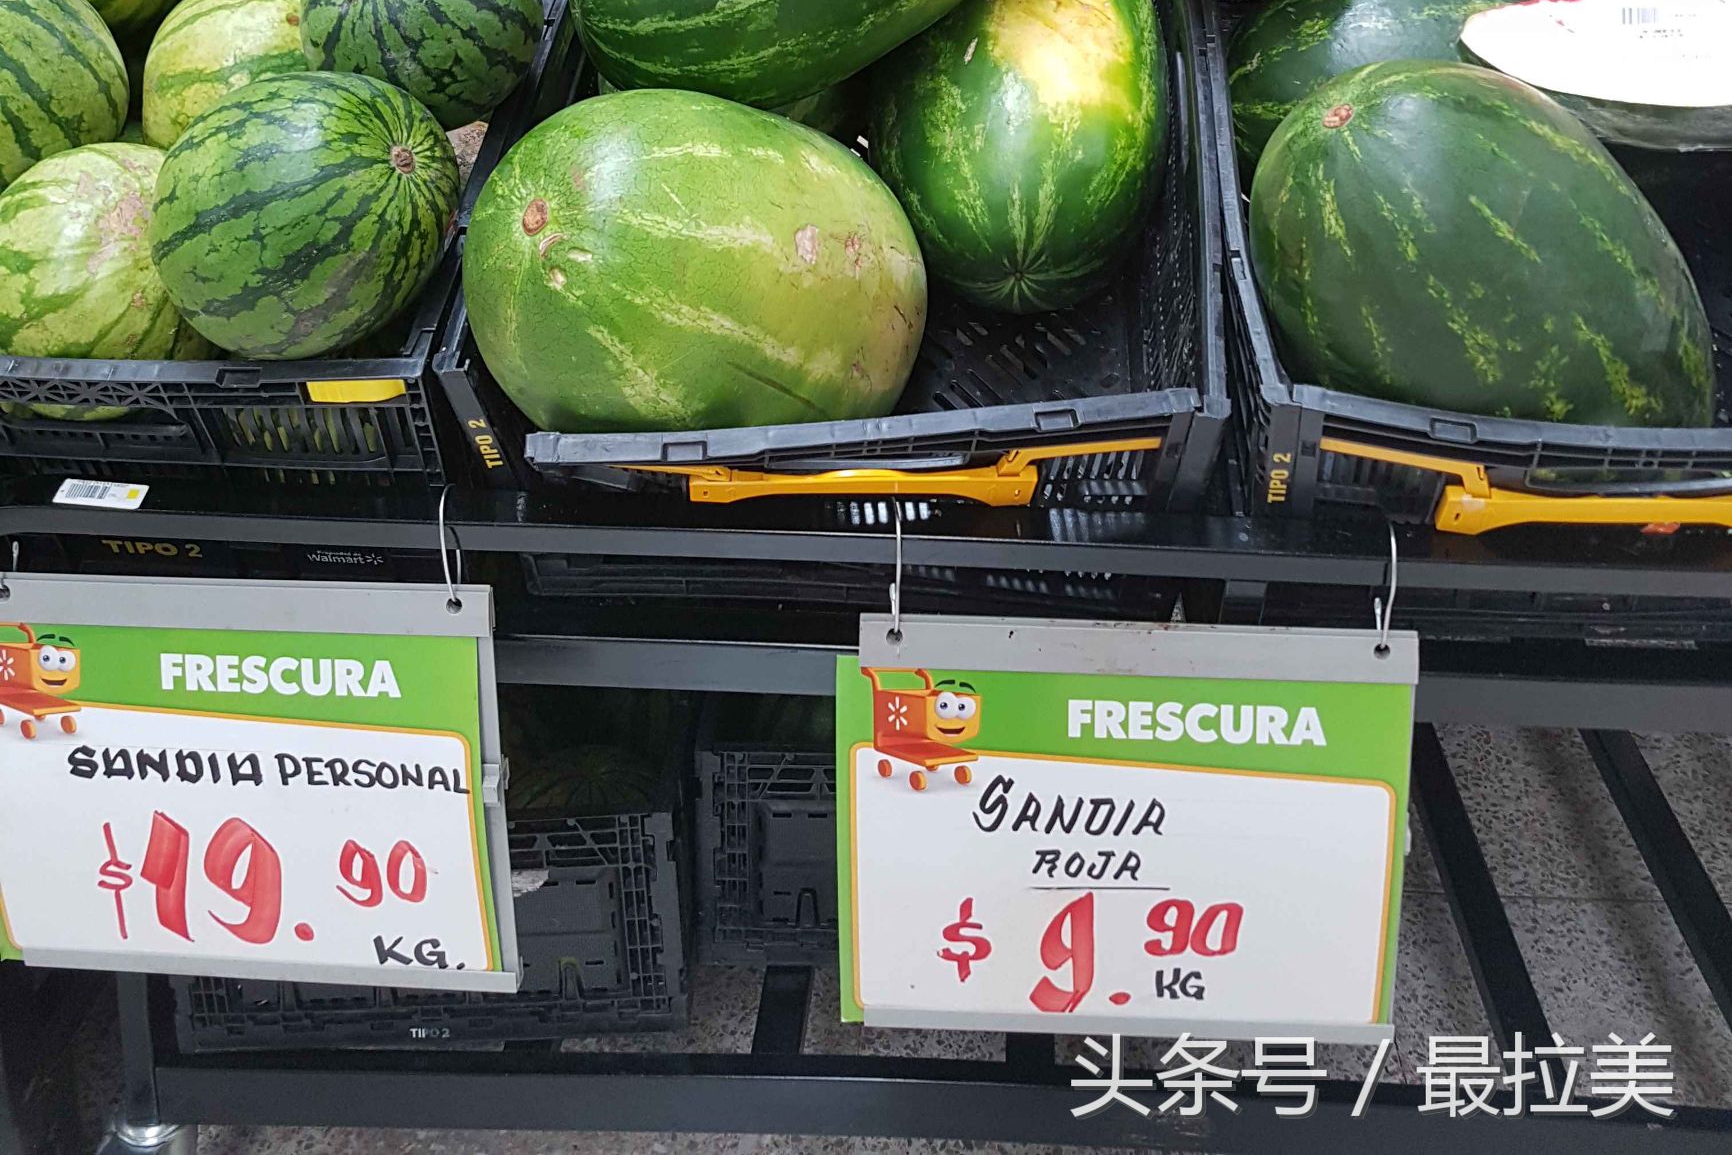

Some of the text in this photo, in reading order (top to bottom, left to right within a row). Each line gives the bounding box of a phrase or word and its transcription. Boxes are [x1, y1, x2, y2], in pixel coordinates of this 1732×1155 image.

[467, 418, 504, 469] TIPO 2
[1267, 452, 1291, 503] TIPO 2
[101, 539, 203, 558] TIPO 2
[307, 554, 365, 564] Walmart
[160, 652, 402, 698] FRESCURA
[1067, 698, 1327, 746] FRESCURA
[67, 745, 471, 794] SANDIA PERSONAL
[972, 774, 1167, 836] SANDIA
[1032, 848, 1142, 881] ROJA
[1155, 967, 1206, 1000] KG
[409, 1027, 450, 1038] TIPO 2
